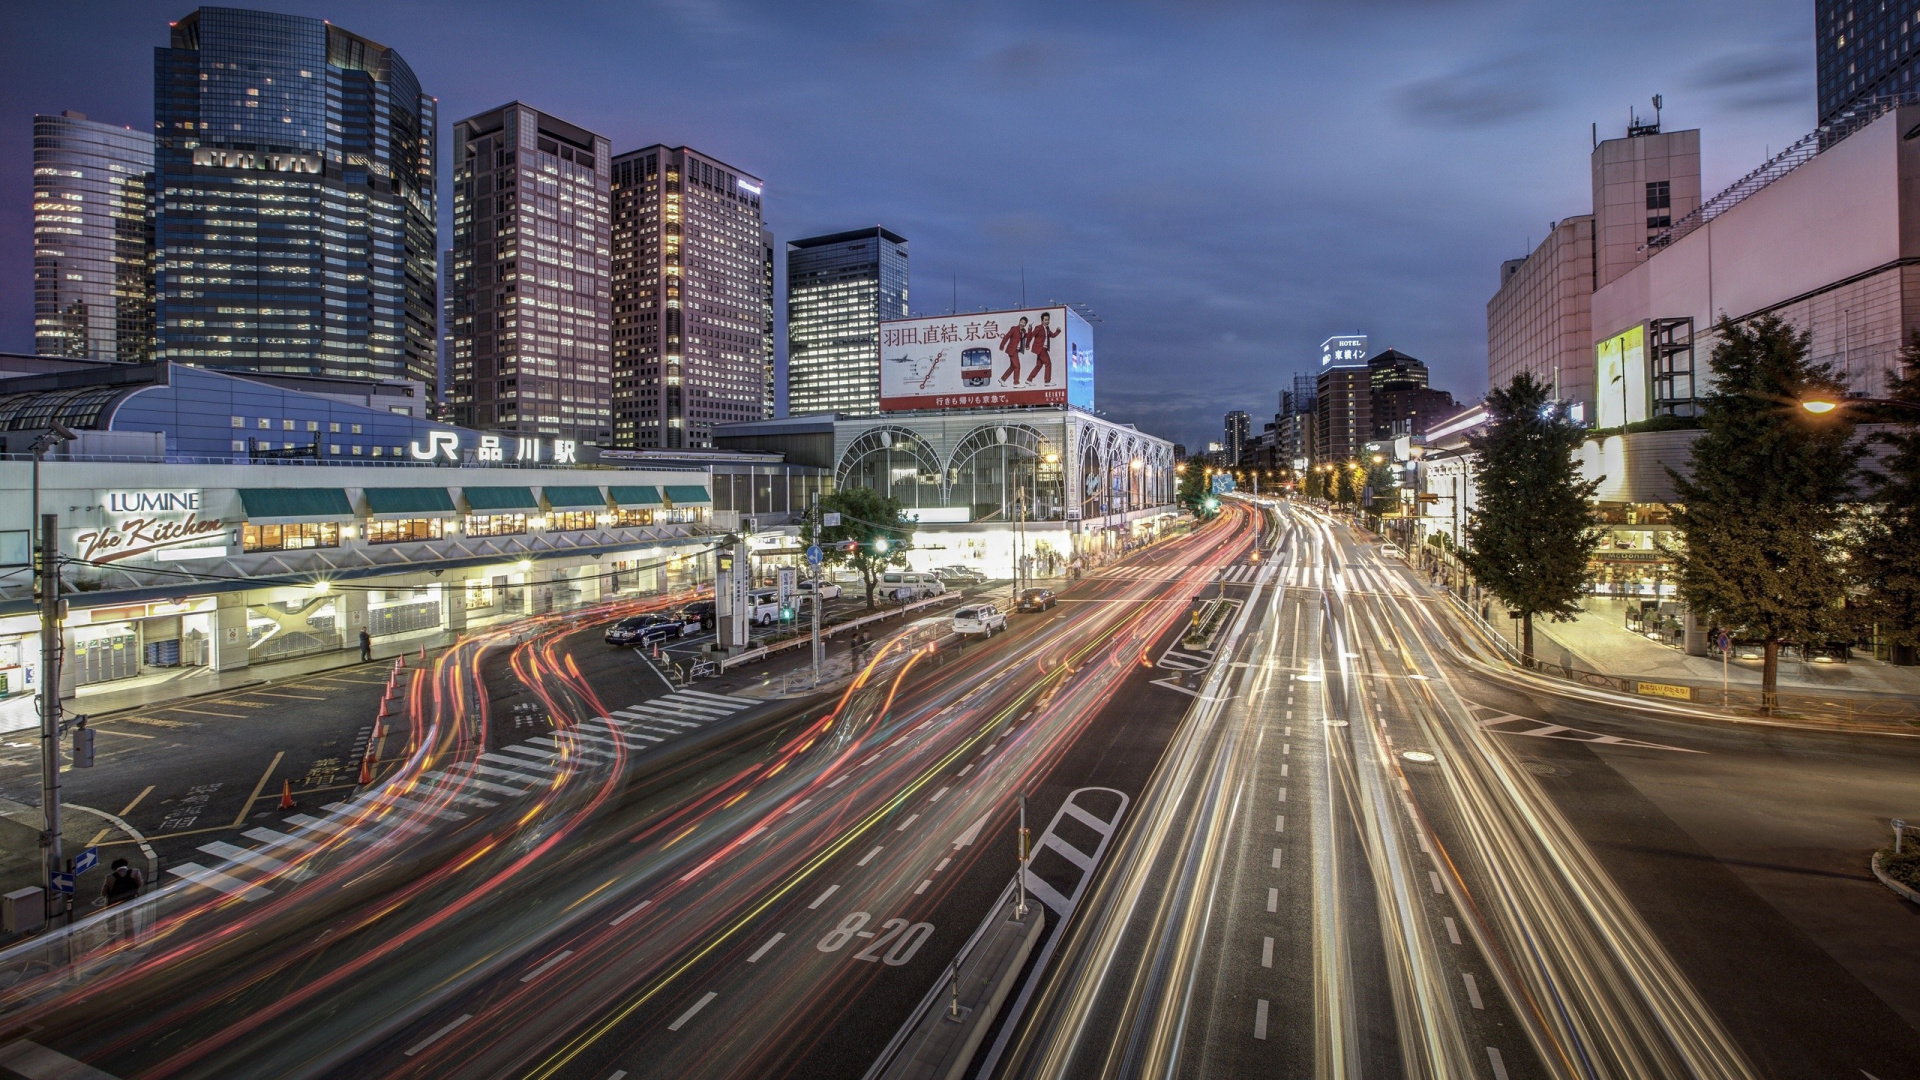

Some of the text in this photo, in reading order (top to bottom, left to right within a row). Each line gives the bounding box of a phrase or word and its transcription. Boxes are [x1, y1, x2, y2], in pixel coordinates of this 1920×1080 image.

[883, 320, 1005, 347] 羽田、直結、京急。
[936, 394, 1009, 406] 行きも帰りも京急で。
[411, 431, 576, 464] JR 品川駅
[111, 492, 199, 512] LUMINE
[78, 513, 224, 561] The Kitchen
[816, 911, 936, 967] 8-20
